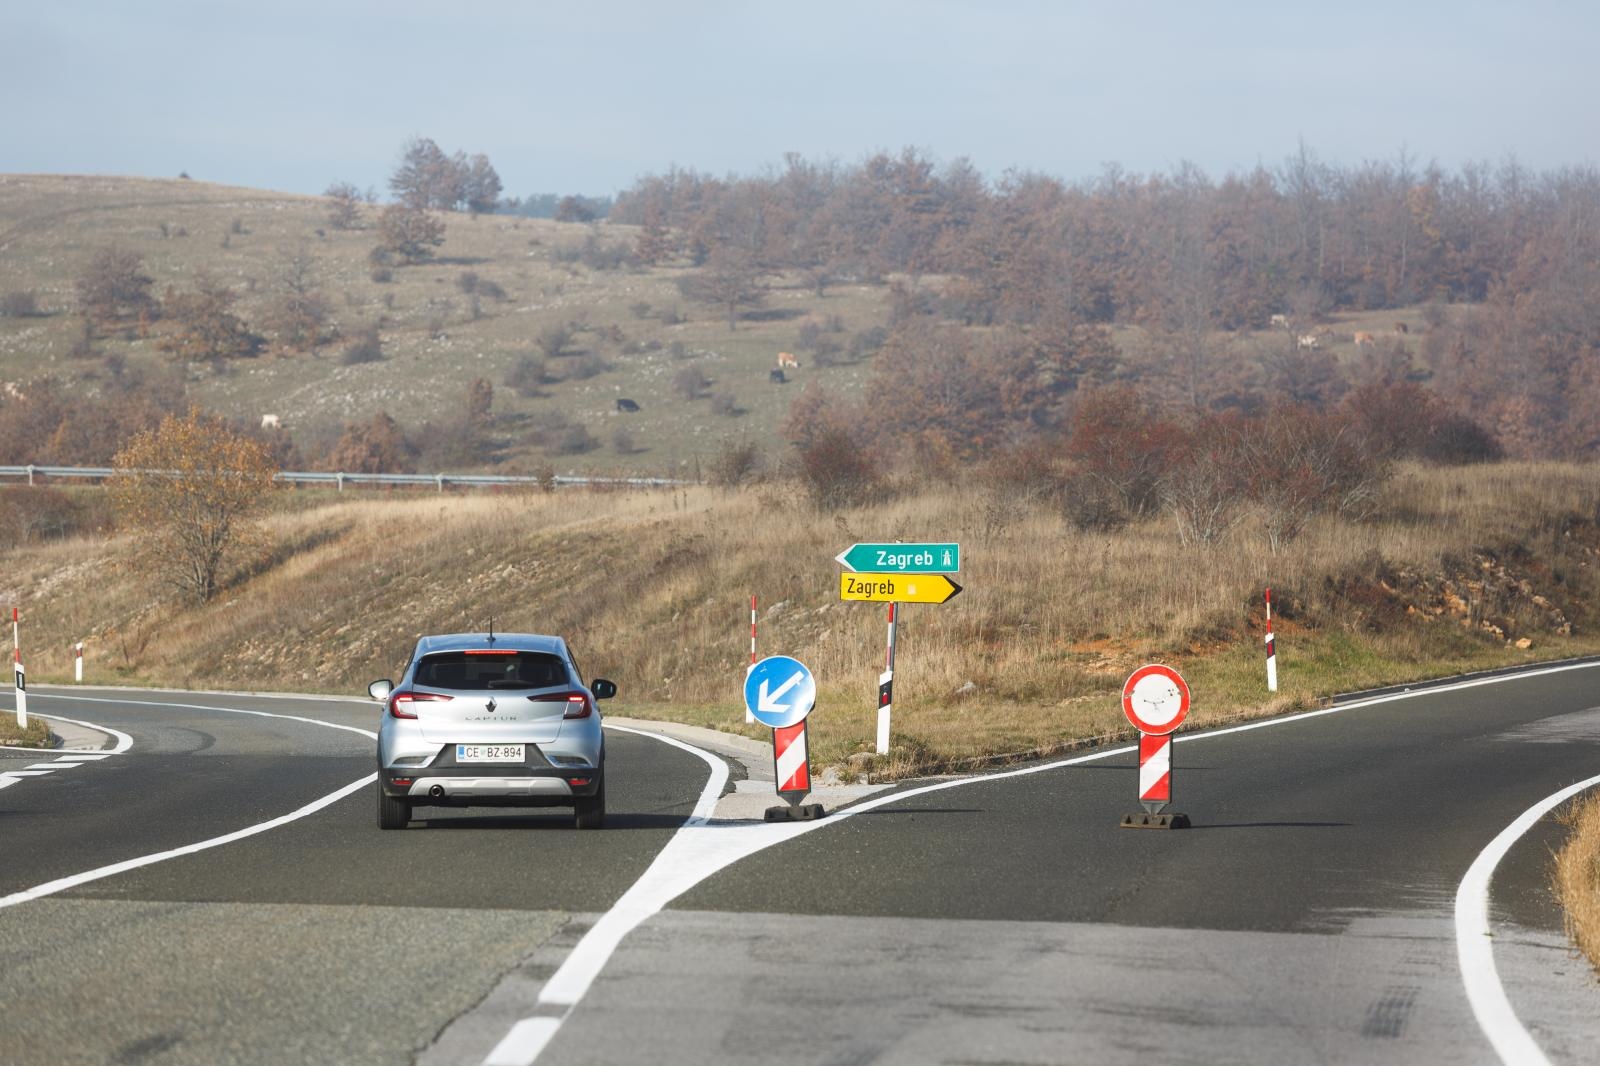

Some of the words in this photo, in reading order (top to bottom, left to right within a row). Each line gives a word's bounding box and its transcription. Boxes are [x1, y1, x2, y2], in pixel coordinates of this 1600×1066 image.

[876, 550, 933, 569] Zagreb
[847, 578, 895, 598] Zagreb
[466, 747, 479, 758] CE
